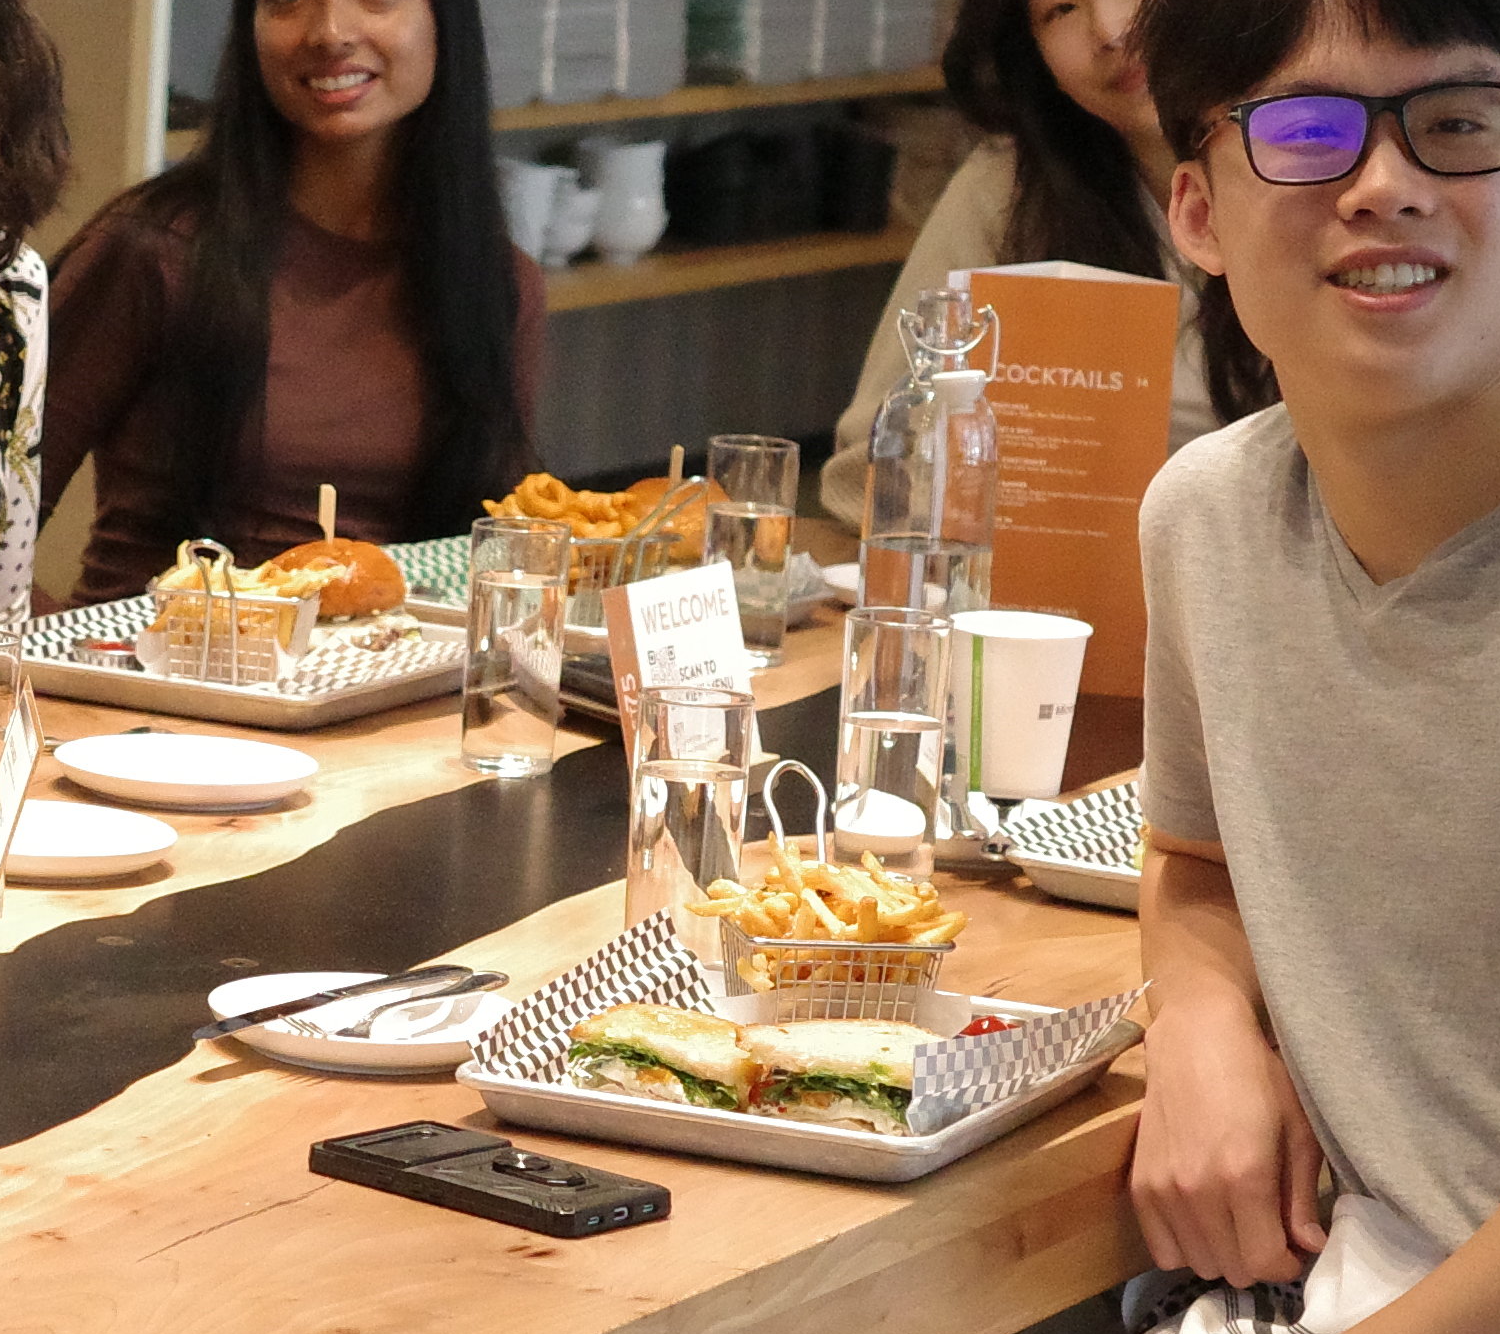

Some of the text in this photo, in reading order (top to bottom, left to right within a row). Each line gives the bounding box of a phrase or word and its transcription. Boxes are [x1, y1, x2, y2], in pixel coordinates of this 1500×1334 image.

[993, 363, 1124, 391] COCKTAILS
[641, 589, 729, 634] WELCOME
[679, 659, 717, 681] SCAN TO
